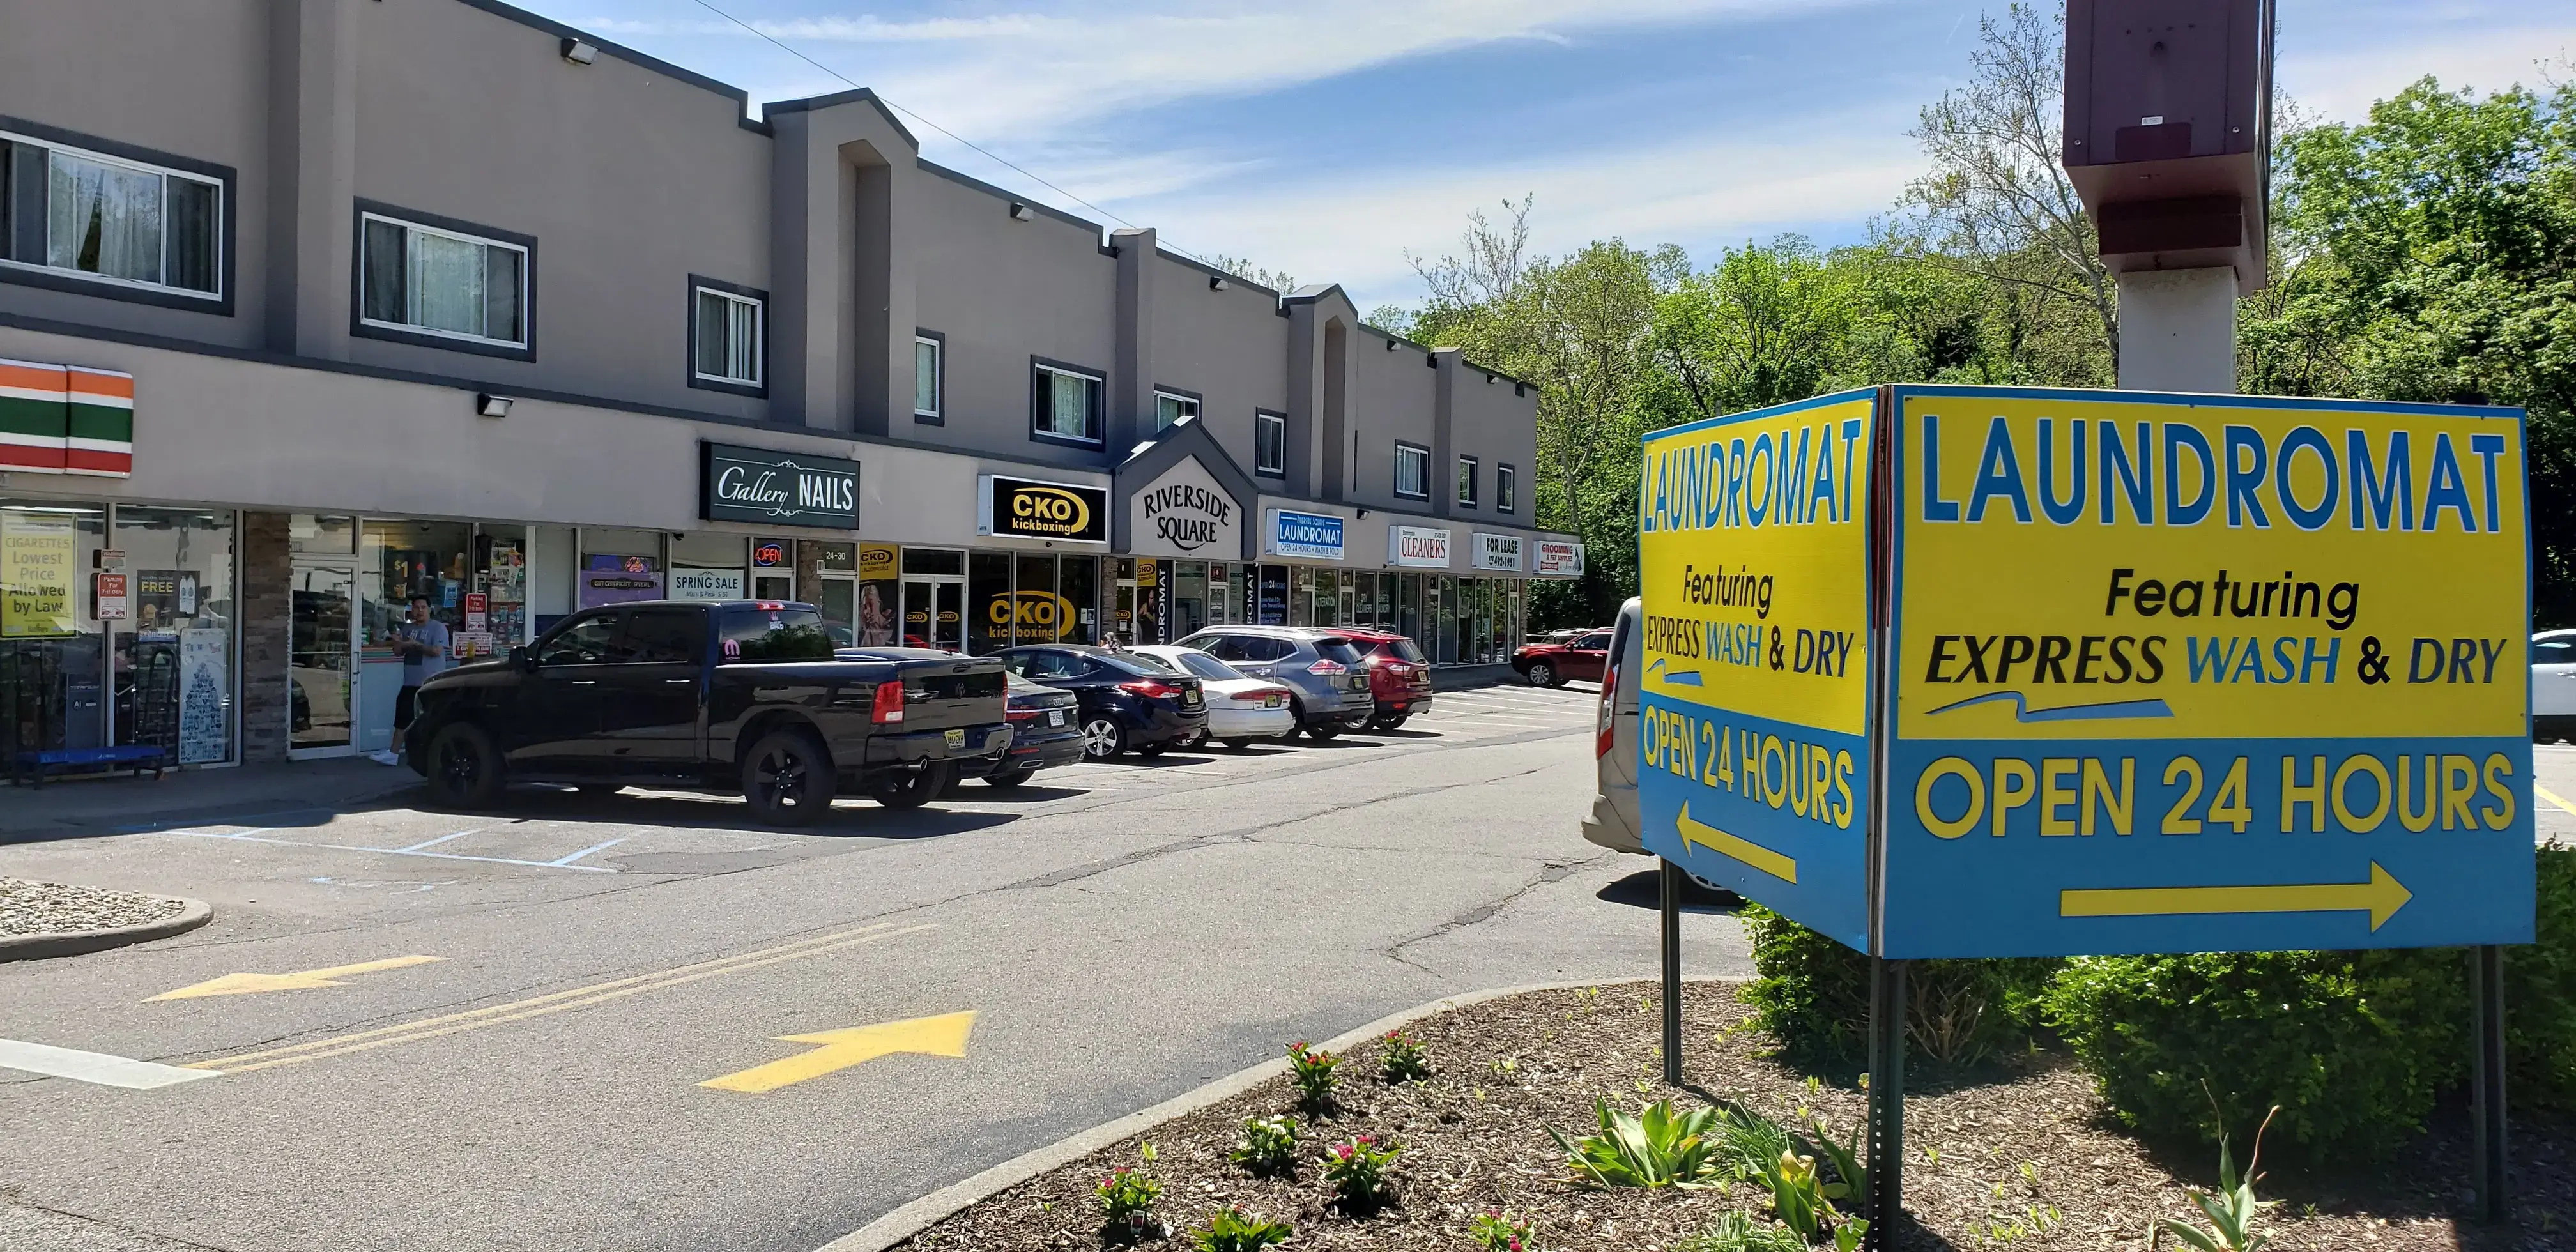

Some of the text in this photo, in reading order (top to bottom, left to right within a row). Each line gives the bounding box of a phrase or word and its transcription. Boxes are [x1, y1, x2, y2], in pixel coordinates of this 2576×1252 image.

[1643, 418, 1862, 533] LAUNDROMAT
[1922, 415, 2506, 534] LAUNDROMAT
[718, 466, 853, 516] Gallery NAILS
[1013, 494, 1071, 521] CKO
[1144, 485, 1230, 527] RIVERSIDE
[1012, 517, 1071, 535] kickboxing
[1157, 517, 1217, 551] SQUARE
[1279, 524, 1341, 544] LAUNDROMAT
[5, 538, 70, 549] CIGARETTES
[1281, 543, 1292, 551] OPEN
[1292, 543, 1297, 551] 24
[1298, 544, 1311, 553] HOURS
[1402, 537, 1445, 559] CLEANERS
[1486, 537, 1517, 554] FOR LEASE
[1542, 544, 1573, 554] GROOMING
[13, 551, 63, 565] Lowest
[756, 549, 782, 561] OPEN
[826, 551, 846, 560] 24-30
[861, 553, 885, 561] CKO
[20, 567, 55, 581] Price
[677, 577, 738, 589] SPRING SALE
[9, 583, 66, 597] Allowed
[141, 582, 173, 592] FREE
[1269, 580, 1275, 588] 24
[1683, 565, 1774, 619] Featuring
[13, 599, 63, 616] by Law
[2105, 569, 2360, 631] Featuring
[990, 600, 1055, 624] CKO
[1647, 615, 1854, 678] EXPRESS WASH & DRY
[1925, 635, 2507, 685] EXPRESS WASH & DRY
[1643, 705, 1853, 830] OPEN 24 HOURS
[1915, 752, 2515, 839] OPEN 24 HOURS
